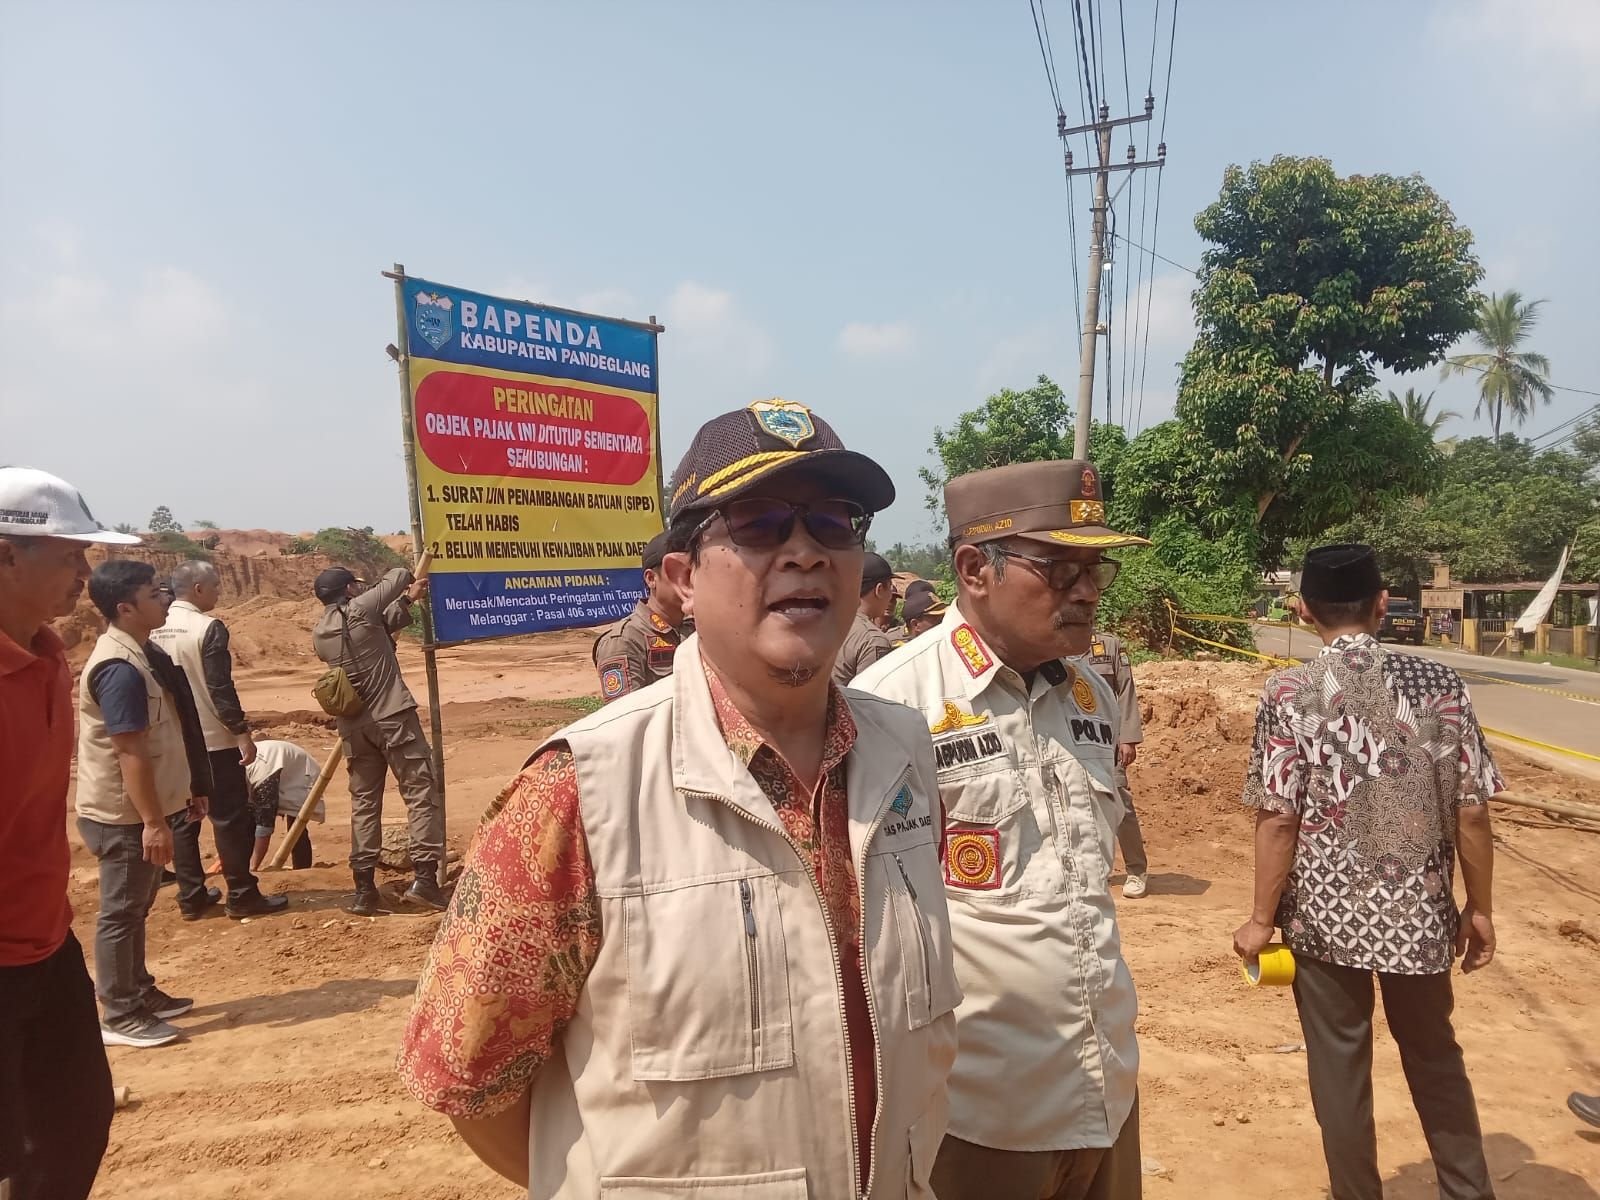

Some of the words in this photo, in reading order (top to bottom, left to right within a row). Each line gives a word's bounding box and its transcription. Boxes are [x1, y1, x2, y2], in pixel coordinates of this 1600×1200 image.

[460, 300, 602, 350] BAPENDA
[460, 331, 557, 362] KABUPATEN
[561, 347, 650, 378] PANDEGLANG
[493, 387, 593, 422] PERINGATAN
[425, 412, 470, 437] OBJEK
[474, 418, 516, 441] PAJAK
[518, 422, 536, 442] INI
[538, 425, 582, 448] DITUTUP
[584, 432, 643, 454] SEMENTARA
[507, 448, 582, 473] SEHUBUNGAN
[427, 485, 440, 503] 1.
[442, 485, 483, 504] SURAT
[486, 488, 505, 505] IJIN
[508, 490, 585, 509] PENAMBANGAN
[587, 493, 622, 510] BATUAN
[624, 495, 655, 513] (SIPB)
[446, 514, 483, 531] TELAH
[486, 515, 519, 532] HABIS
[432, 543, 443, 559] 2.
[446, 541, 484, 559] BELUM
[486, 542, 540, 559] MEMENUHI
[542, 542, 595, 558] KEWAJIBAN
[597, 542, 624, 557] PAJAK
[505, 577, 562, 590] ANCAMAN
[564, 575, 604, 587] PIDANA
[445, 595, 547, 611] Merusak/Mencabut
[550, 593, 600, 608] Peringatan
[602, 591, 615, 601] ini
[616, 590, 642, 603] Tanpa
[470, 613, 528, 627] Melanggar
[537, 610, 565, 620] Pasal
[568, 607, 585, 618] 406
[587, 606, 606, 620] ayat
[608, 604, 621, 617] (1)
